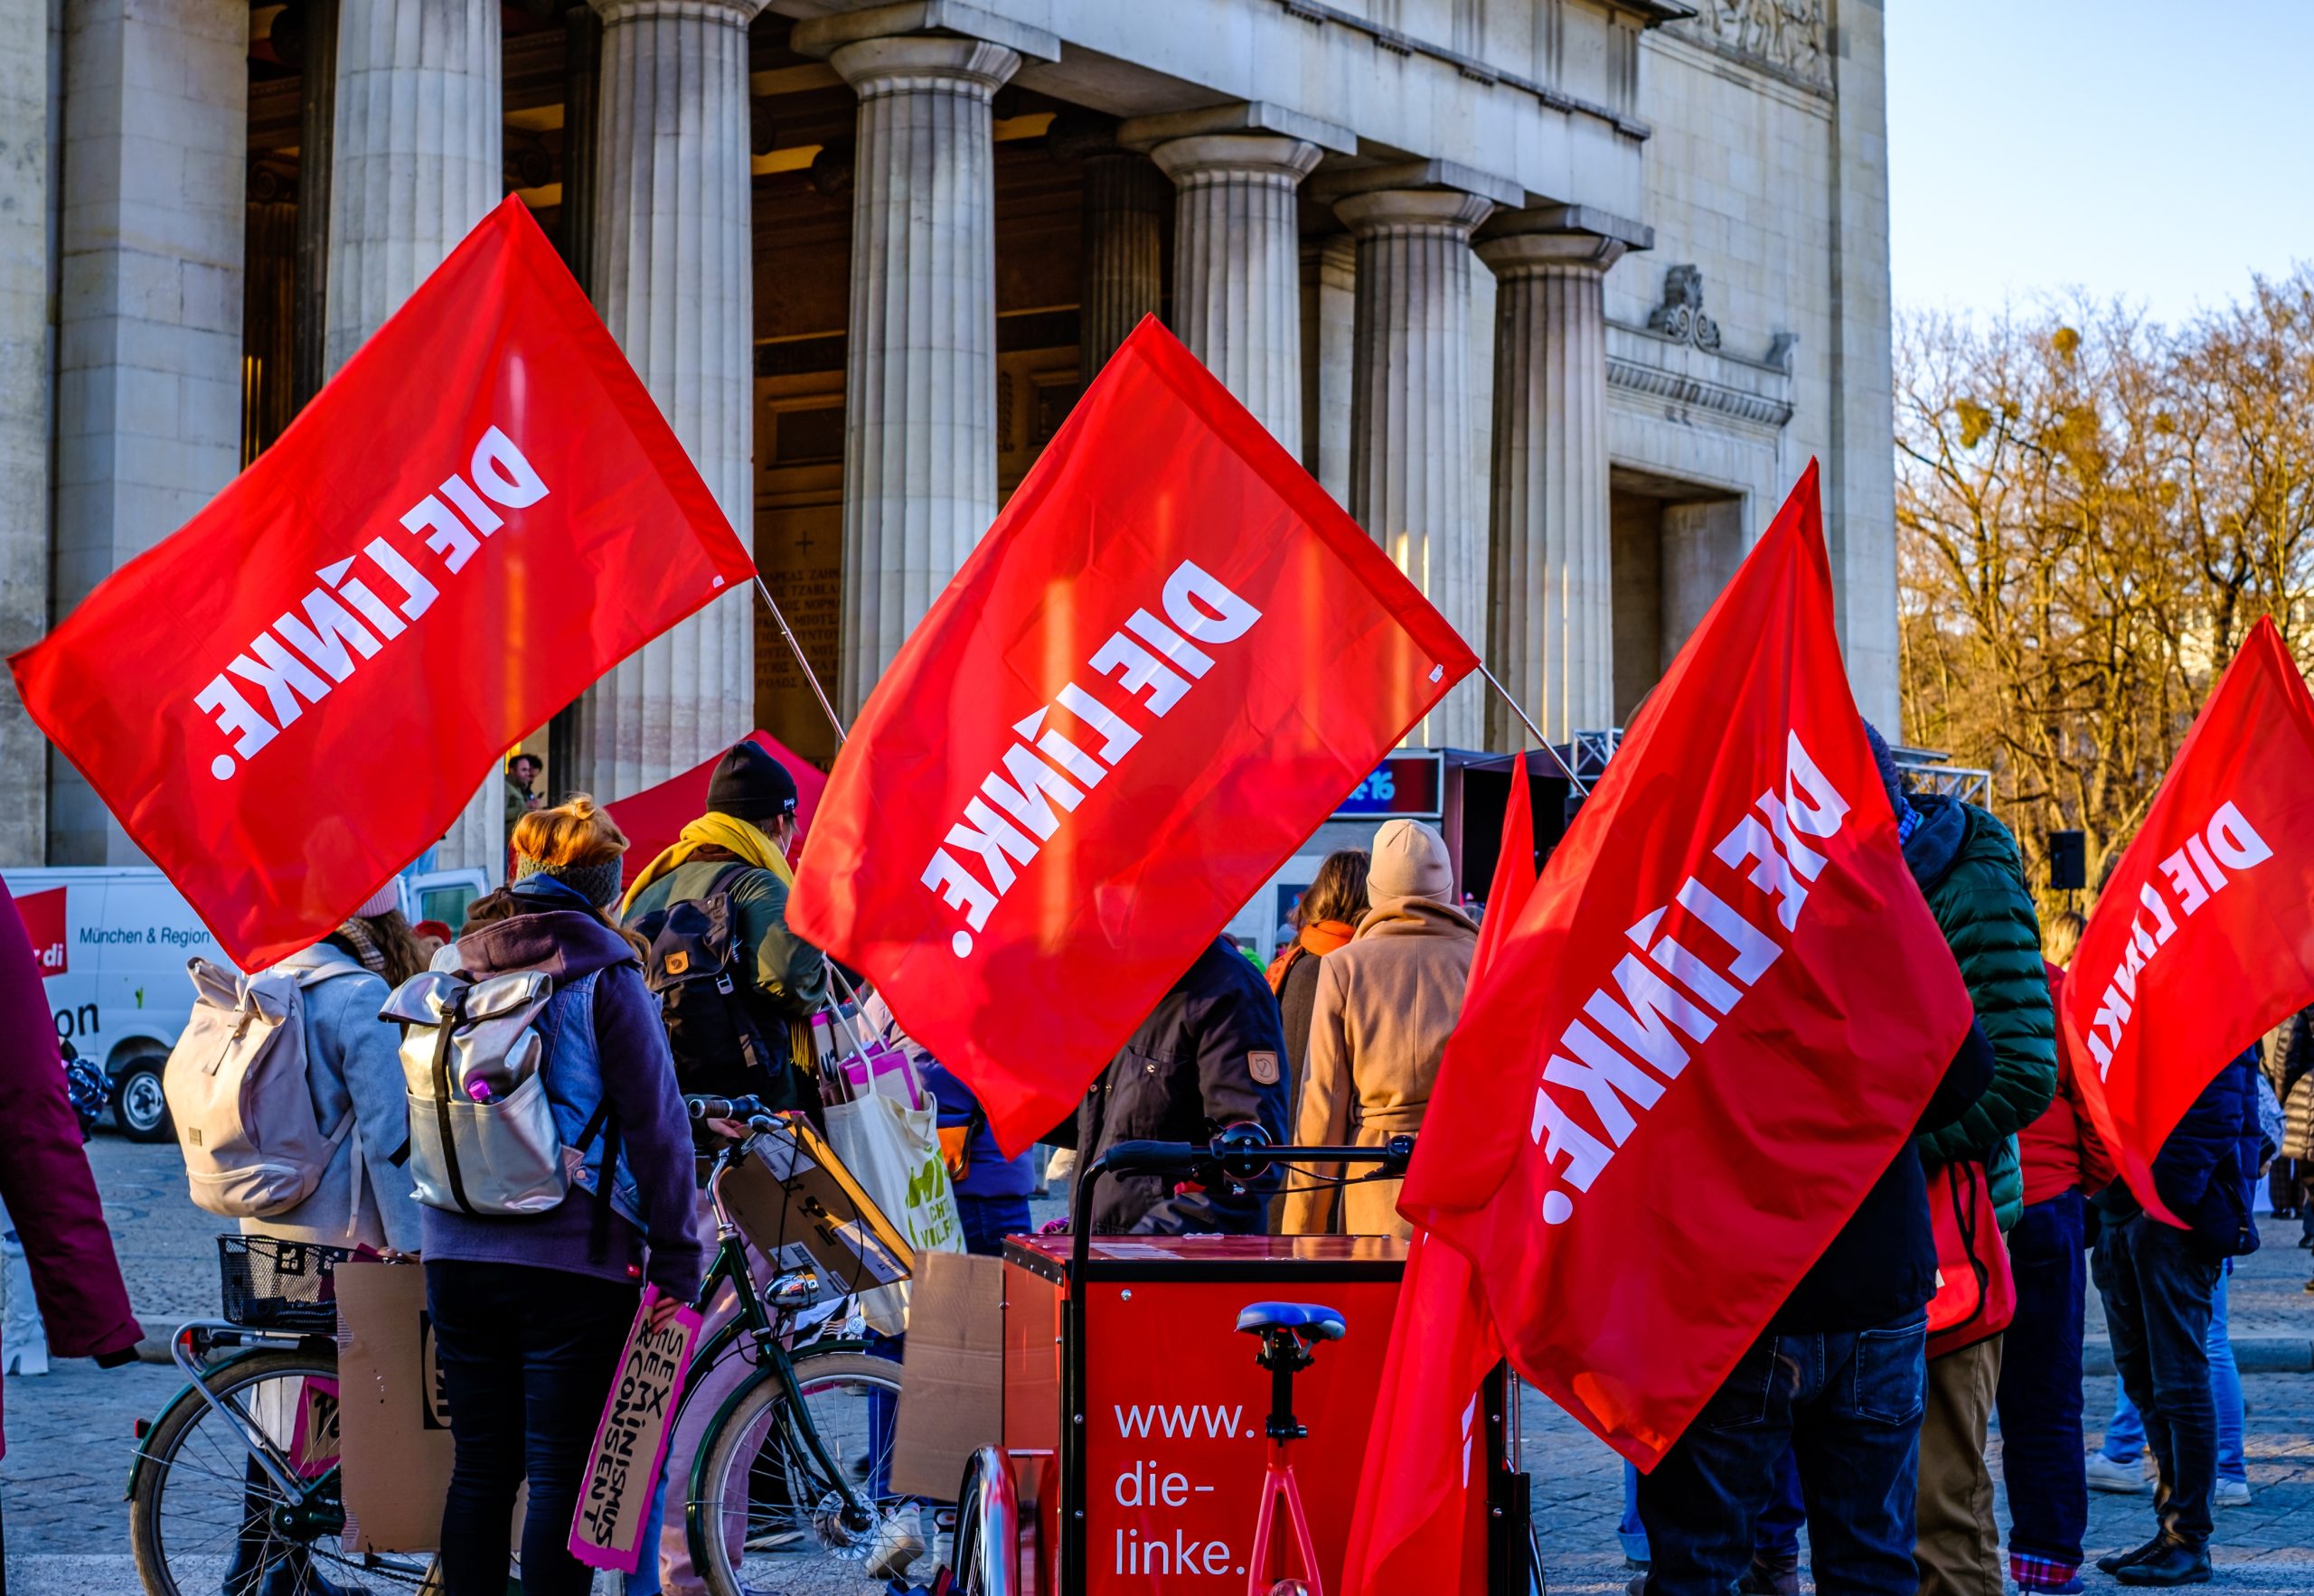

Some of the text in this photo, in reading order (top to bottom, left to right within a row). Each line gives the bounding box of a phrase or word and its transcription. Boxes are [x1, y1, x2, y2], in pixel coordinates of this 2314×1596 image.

[79, 926, 210, 948] München & Region
[54, 1002, 100, 1038] on
[647, 1328, 684, 1421] SEX
[583, 1349, 643, 1534] CONSENT
[1115, 1404, 1255, 1439] www.
[1115, 1460, 1215, 1507] die-
[1115, 1528, 1246, 1575] linke.
